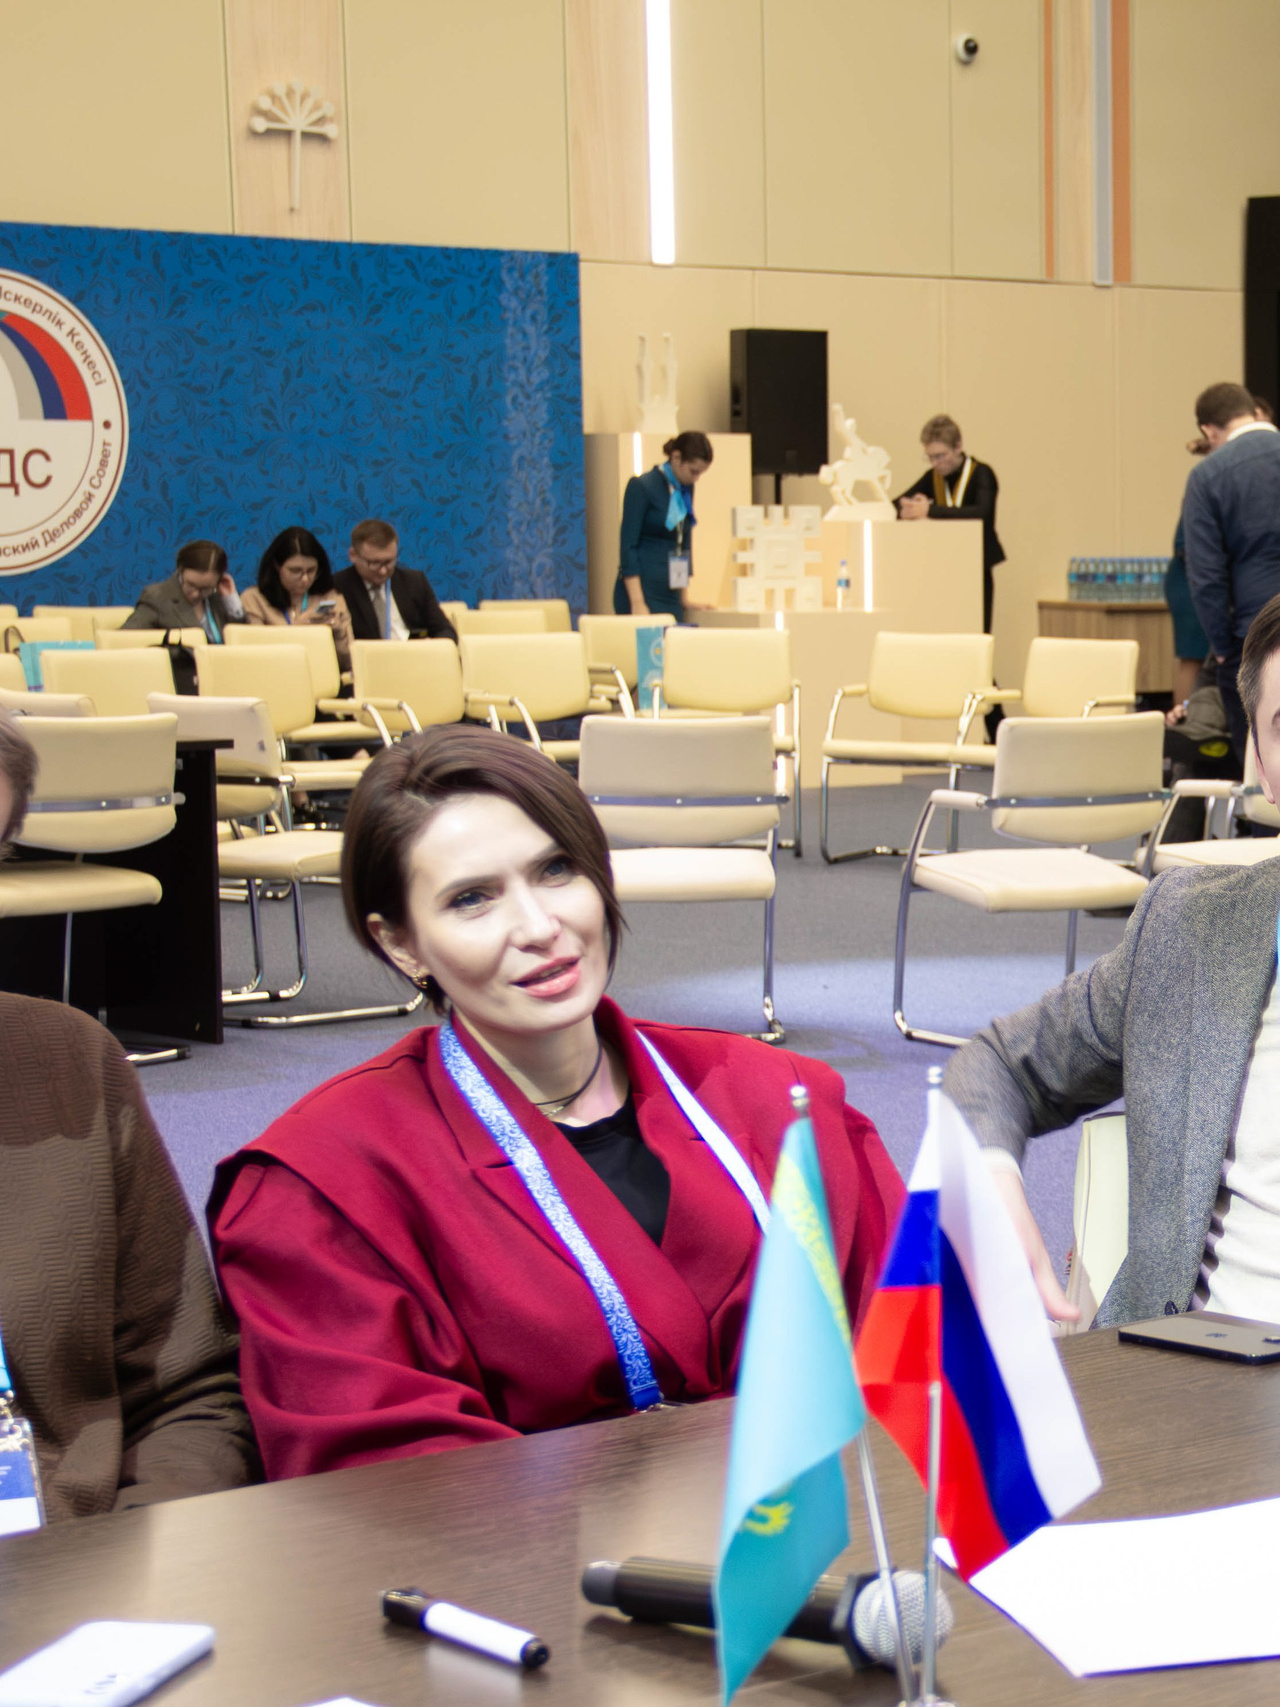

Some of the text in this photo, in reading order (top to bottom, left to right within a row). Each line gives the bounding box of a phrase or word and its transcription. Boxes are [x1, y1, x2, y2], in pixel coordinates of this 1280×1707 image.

[66, 326, 107, 386] Кеңесі
[0, 439, 112, 558] ский Деловой Совет
